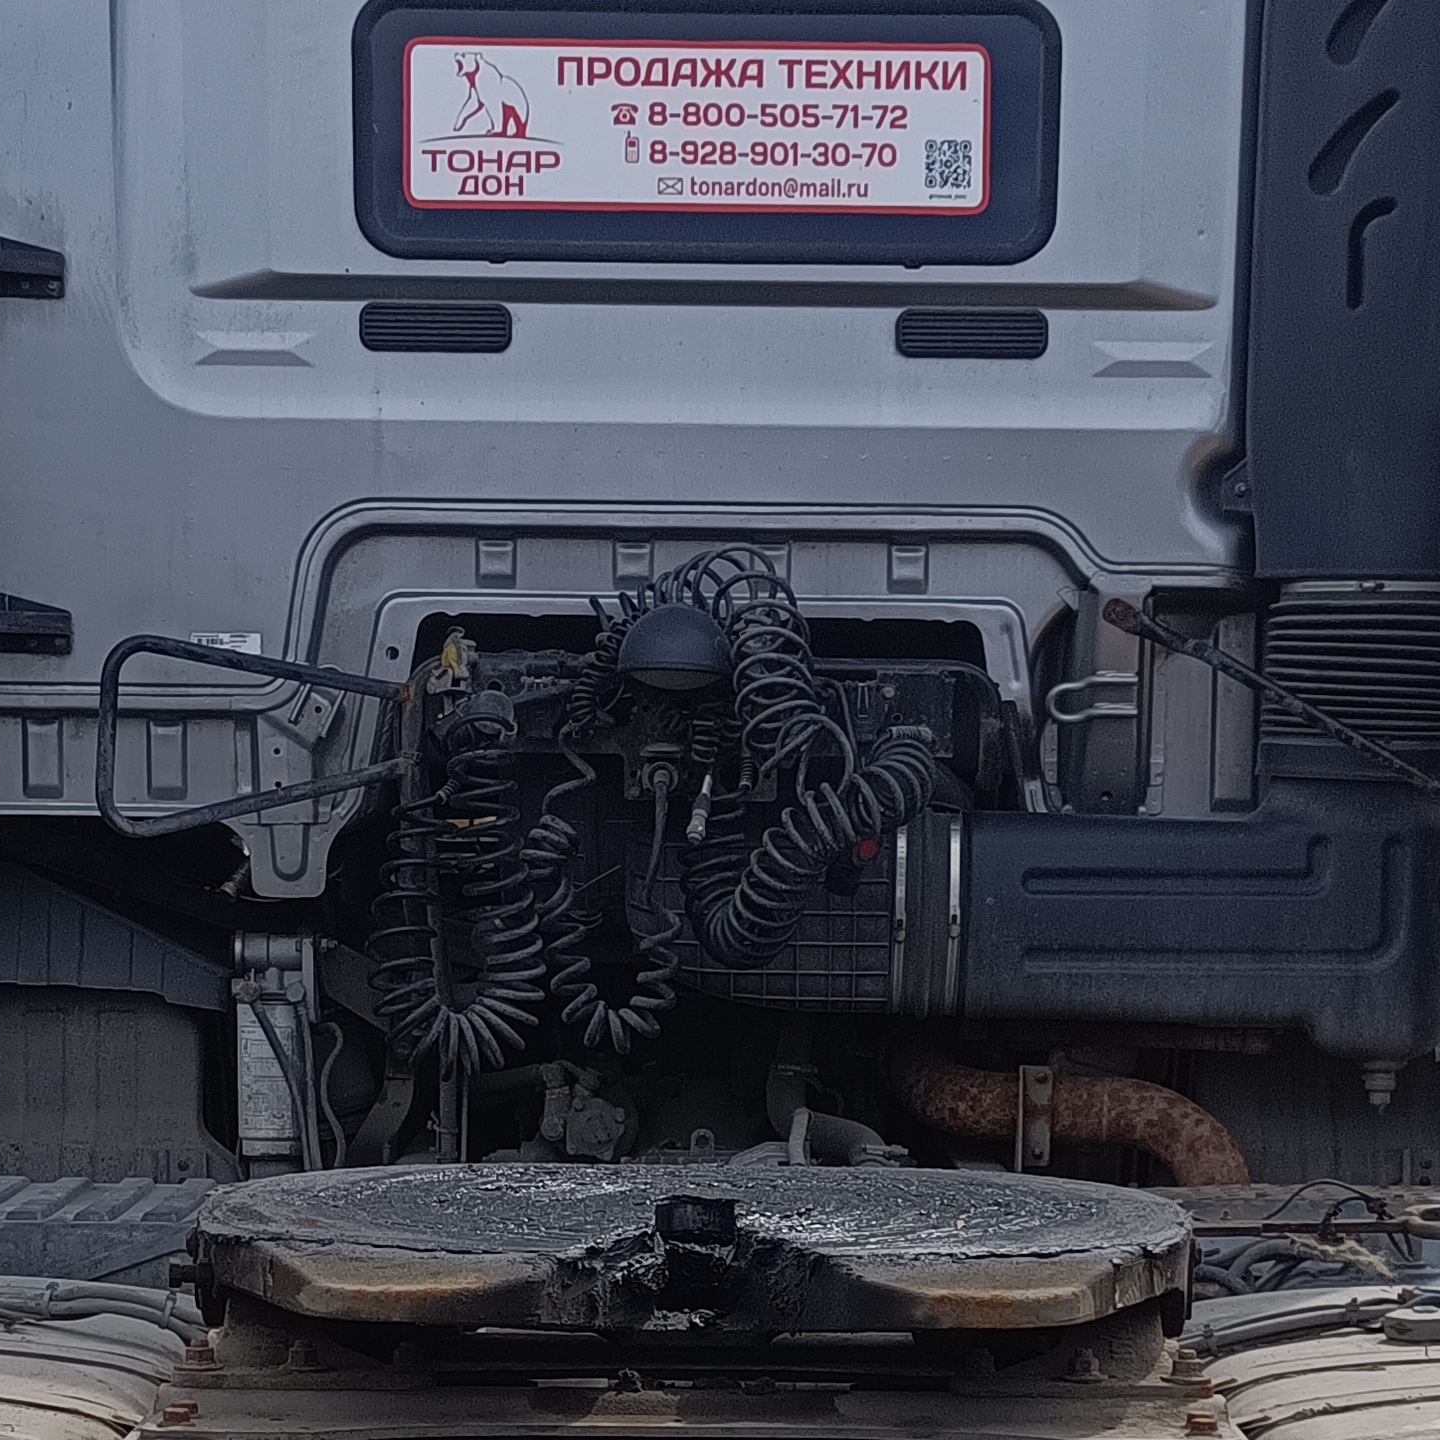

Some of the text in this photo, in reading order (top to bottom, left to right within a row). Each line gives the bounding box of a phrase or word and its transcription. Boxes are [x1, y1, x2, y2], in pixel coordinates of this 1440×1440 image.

[557, 56, 968, 91] ПРОДАЖА ТЕХНИКИ
[647, 101, 908, 130] 8-800-505-71-72
[421, 149, 561, 174] ТОНАР
[648, 139, 898, 168] 8-928-901-30-70
[457, 175, 525, 196] ДОН
[689, 176, 870, 200] tonardon@mail.ru
